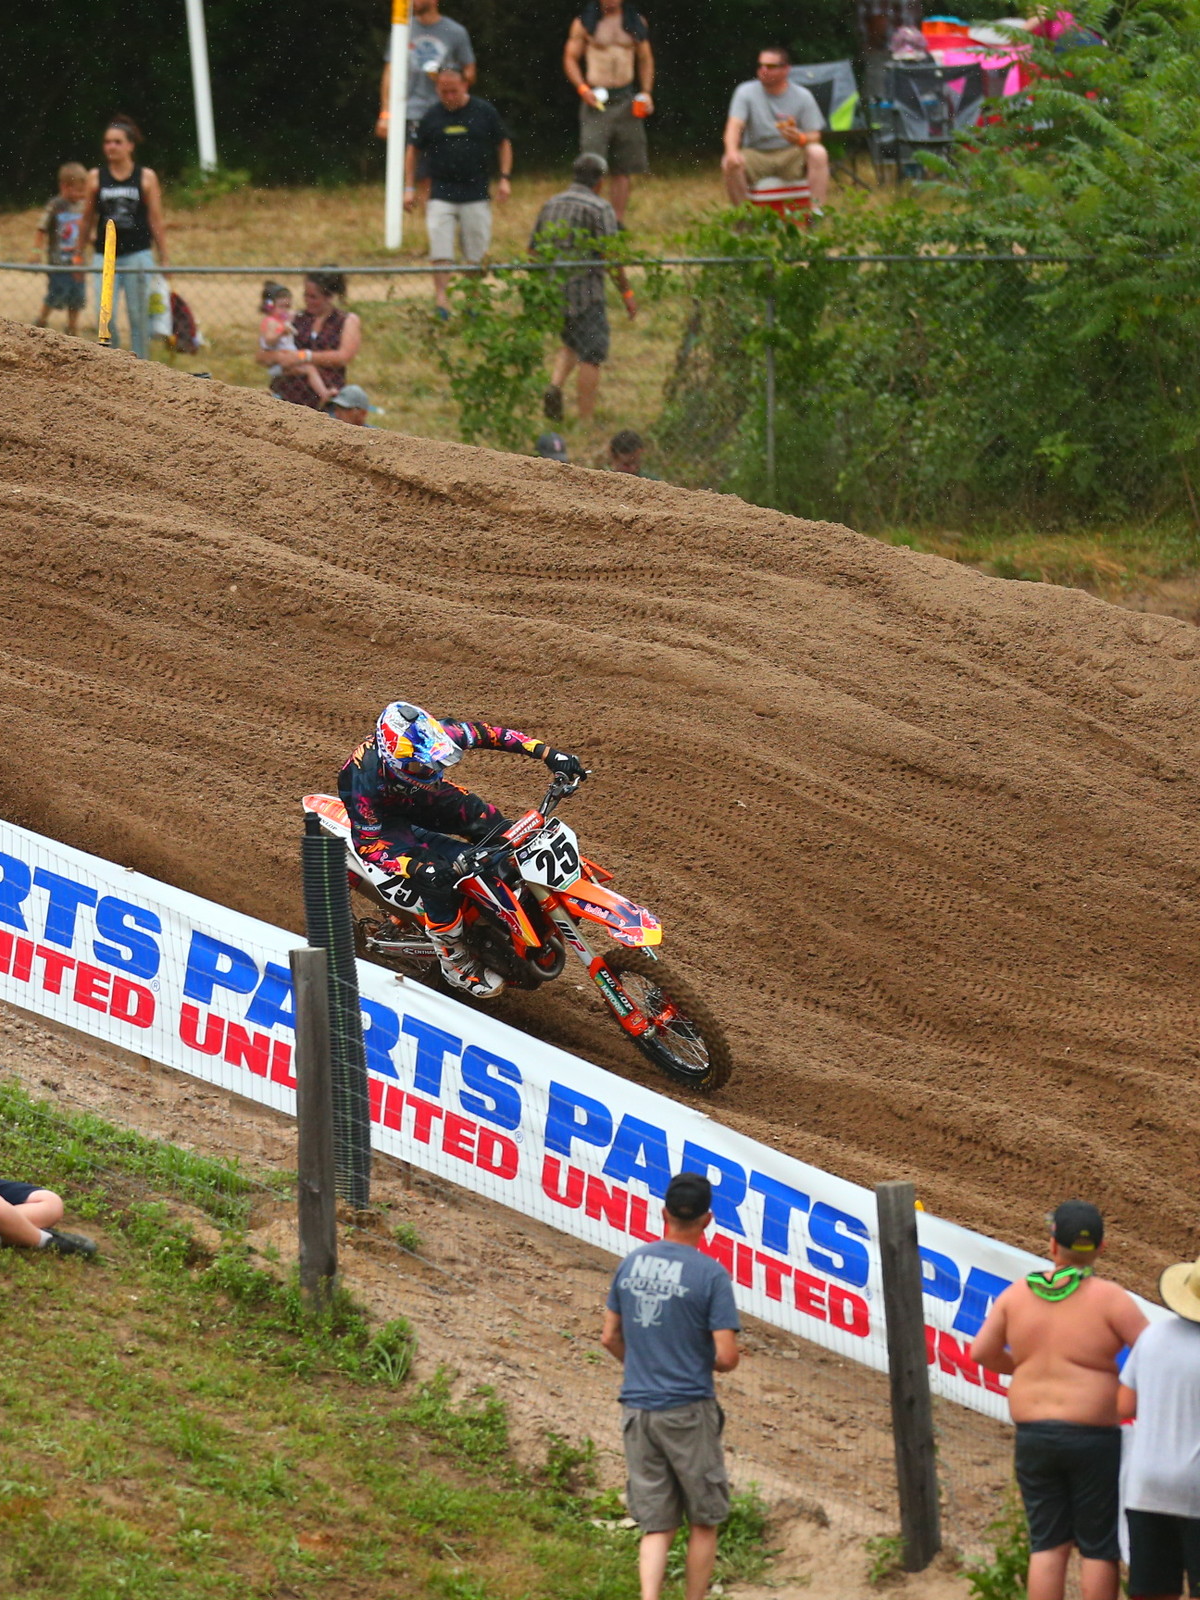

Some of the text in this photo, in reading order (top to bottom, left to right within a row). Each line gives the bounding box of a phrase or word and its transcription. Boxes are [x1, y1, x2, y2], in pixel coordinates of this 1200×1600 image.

[321, 818, 338, 831] NLOP
[535, 832, 579, 888] 25
[377, 873, 422, 908] 25
[600, 970, 634, 1010] DUOP
[600, 984, 627, 1017] MOTOREX
[179, 1002, 519, 1181] UNLITED
[544, 1080, 871, 1288] PARTS
[541, 1154, 870, 1338] UNLMITED
[620, 1276, 690, 1299] COUNTRY
[630, 1254, 685, 1285] NRA
